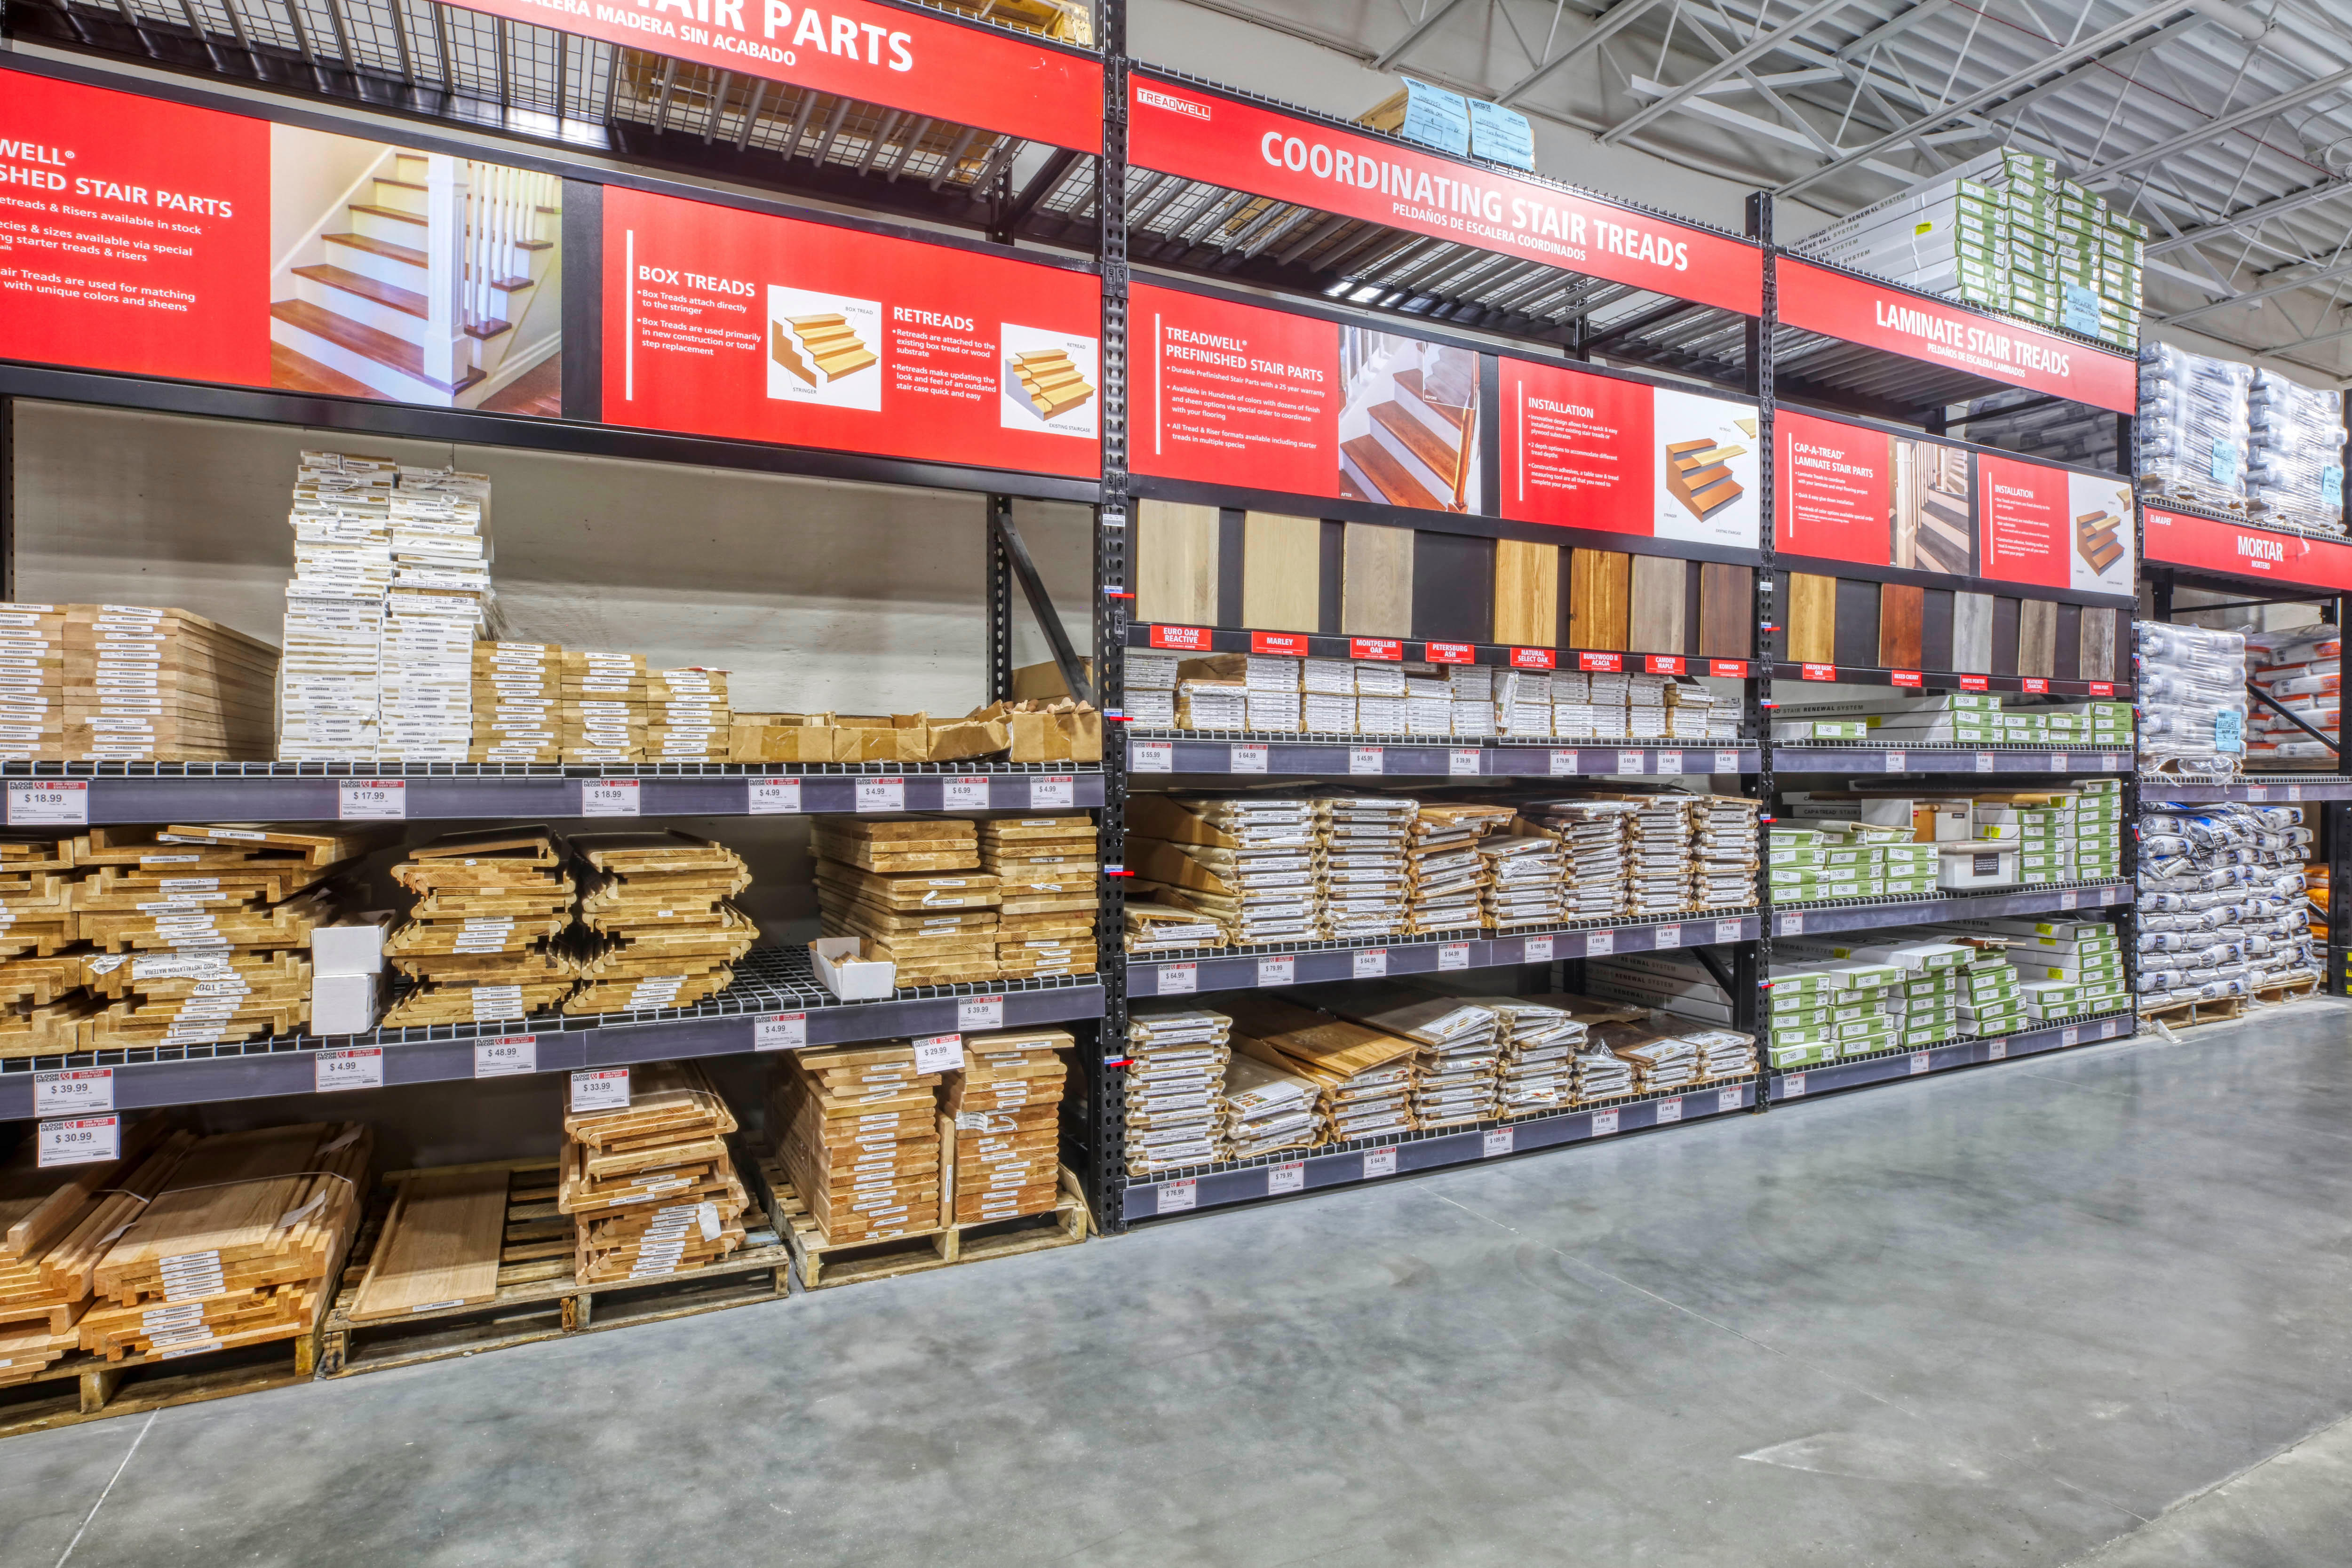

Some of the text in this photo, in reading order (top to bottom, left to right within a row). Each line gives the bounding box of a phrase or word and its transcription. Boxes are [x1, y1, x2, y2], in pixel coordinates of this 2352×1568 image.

[595, 3, 676, 38] MADERA
[680, 25, 708, 45] SIN
[713, 34, 795, 65] ACABADO
[764, 0, 914, 72] PARTS
[1139, 90, 1209, 118] TREADWELL
[76, 178, 148, 205] STAIR
[157, 191, 232, 217] PARTS
[1262, 132, 1688, 271] COORDINATING STAIR TREADS
[1848, 206, 1879, 223] RENEWAL
[1880, 192, 1907, 207] SYSTEM
[50, 204, 58, 212] &
[63, 206, 97, 218] Risers
[101, 213, 154, 227] available
[158, 220, 168, 229] in
[172, 224, 201, 234] stock
[31, 225, 39, 233] &
[44, 228, 72, 238] sizes
[76, 233, 129, 247] available
[133, 240, 150, 249] via
[153, 245, 192, 256] special
[1393, 203, 1585, 261] PELDAÑOS DE ESCALERA COORDINADOS
[17, 236, 58, 248] starter
[62, 242, 100, 255] treads
[104, 248, 112, 256] &
[117, 250, 147, 261] risers
[21, 270, 61, 283] Treads
[88, 281, 116, 290] used
[119, 283, 137, 293] for
[141, 288, 195, 302] matching
[639, 265, 755, 296] BOX TREADS
[4, 281, 32, 291] with
[37, 286, 79, 297] unique
[84, 292, 119, 302] colors
[148, 299, 187, 311] sheens
[643, 289, 747, 313] Box Treads attach directly
[670, 304, 702, 315] stringer
[894, 307, 974, 331] RETREADS
[643, 318, 658, 326] Box
[660, 320, 687, 330] Treads
[726, 331, 761, 342] primarily
[897, 329, 928, 340] Retreads
[943, 337, 973, 346] attached
[1877, 301, 2069, 377] LAMINATE STAIR TREADS
[897, 339, 924, 349] existing
[897, 347, 929, 357] substrate
[1167, 344, 1323, 382] PREFINISHED STAIR PARTS
[1928, 343, 2025, 377] PELDAÑOS DE ESCALERA LAMINADOS
[1529, 397, 1593, 418] INSTALLATION
[1795, 455, 1873, 478] LAMINATE STAIR PARTS
[1995, 485, 2033, 498] INSTALLATION
[2154, 516, 2171, 525] MAPEI
[2238, 535, 2283, 562] MORTAR
[2252, 560, 2270, 569] MORTERO
[1165, 635, 1198, 643] REACTIVE
[25, 794, 31, 803] $
[930, 1046, 946, 1055] 29.99
[51, 1083, 87, 1094] $ 39.99
